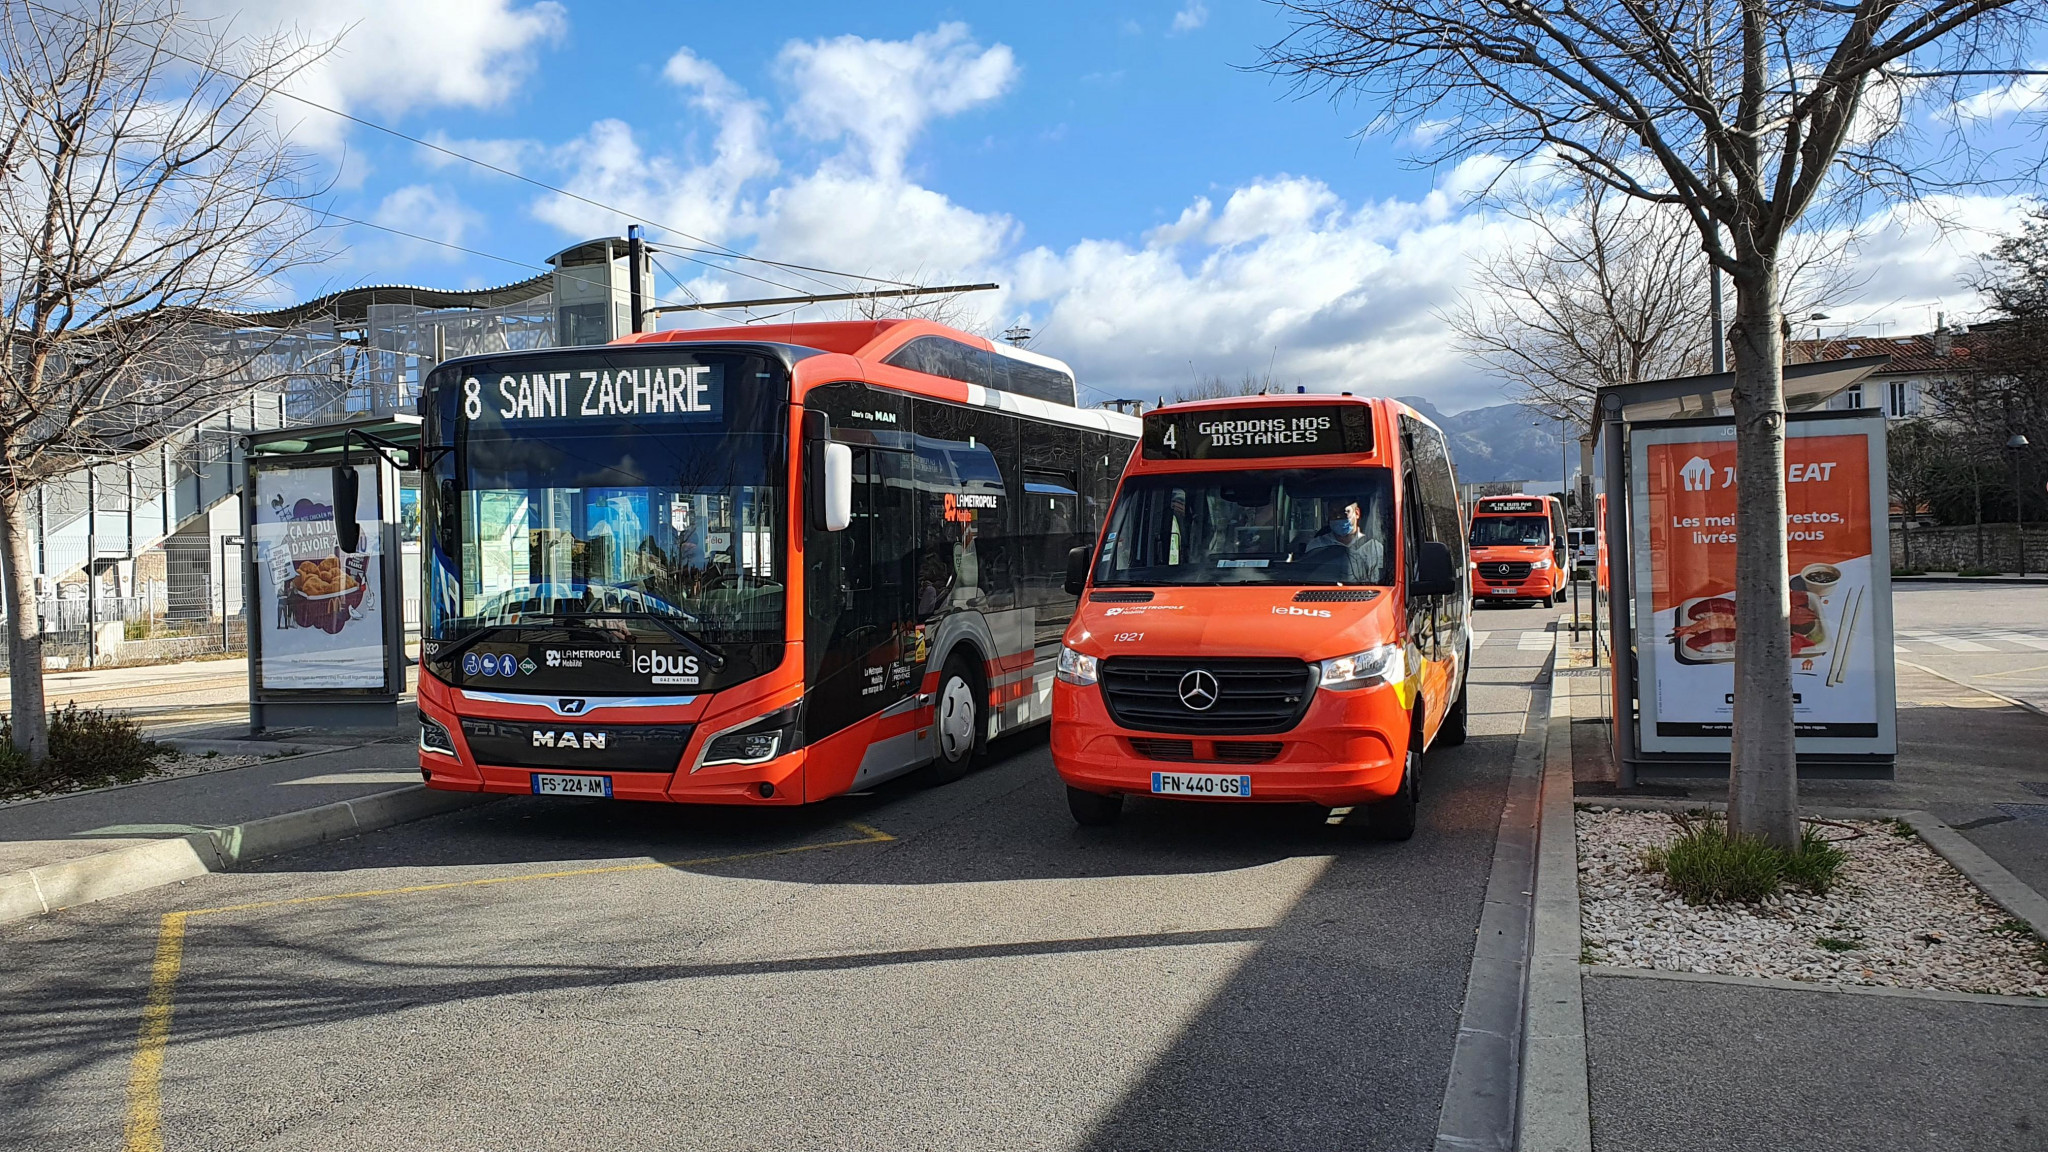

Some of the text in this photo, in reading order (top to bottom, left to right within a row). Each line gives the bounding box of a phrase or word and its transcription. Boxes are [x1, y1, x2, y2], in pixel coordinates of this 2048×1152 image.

[464, 365, 711, 420] 8 SAINT ZACHARIE
[875, 410, 896, 423] MAN
[1199, 416, 1330, 434] GARDONS NOS
[1163, 424, 1176, 450] 4
[1212, 430, 1318, 446] DISTANCES
[1788, 462, 1837, 482] EAT
[956, 494, 997, 508] LAMETROPOLE
[1674, 510, 1844, 528] Les mei restos,
[289, 519, 331, 542] ÇA A DU
[1694, 532, 1736, 544] livrés
[292, 536, 330, 555] D'AVOIR
[1272, 606, 1332, 618] lebus
[1114, 632, 1144, 642] 1921
[562, 650, 620, 659] LAMETROPOLE
[632, 650, 698, 674] lebus
[533, 730, 606, 748] MAN
[542, 778, 602, 793] FS-224-AM
[1162, 776, 1239, 793] FN-440-GS
